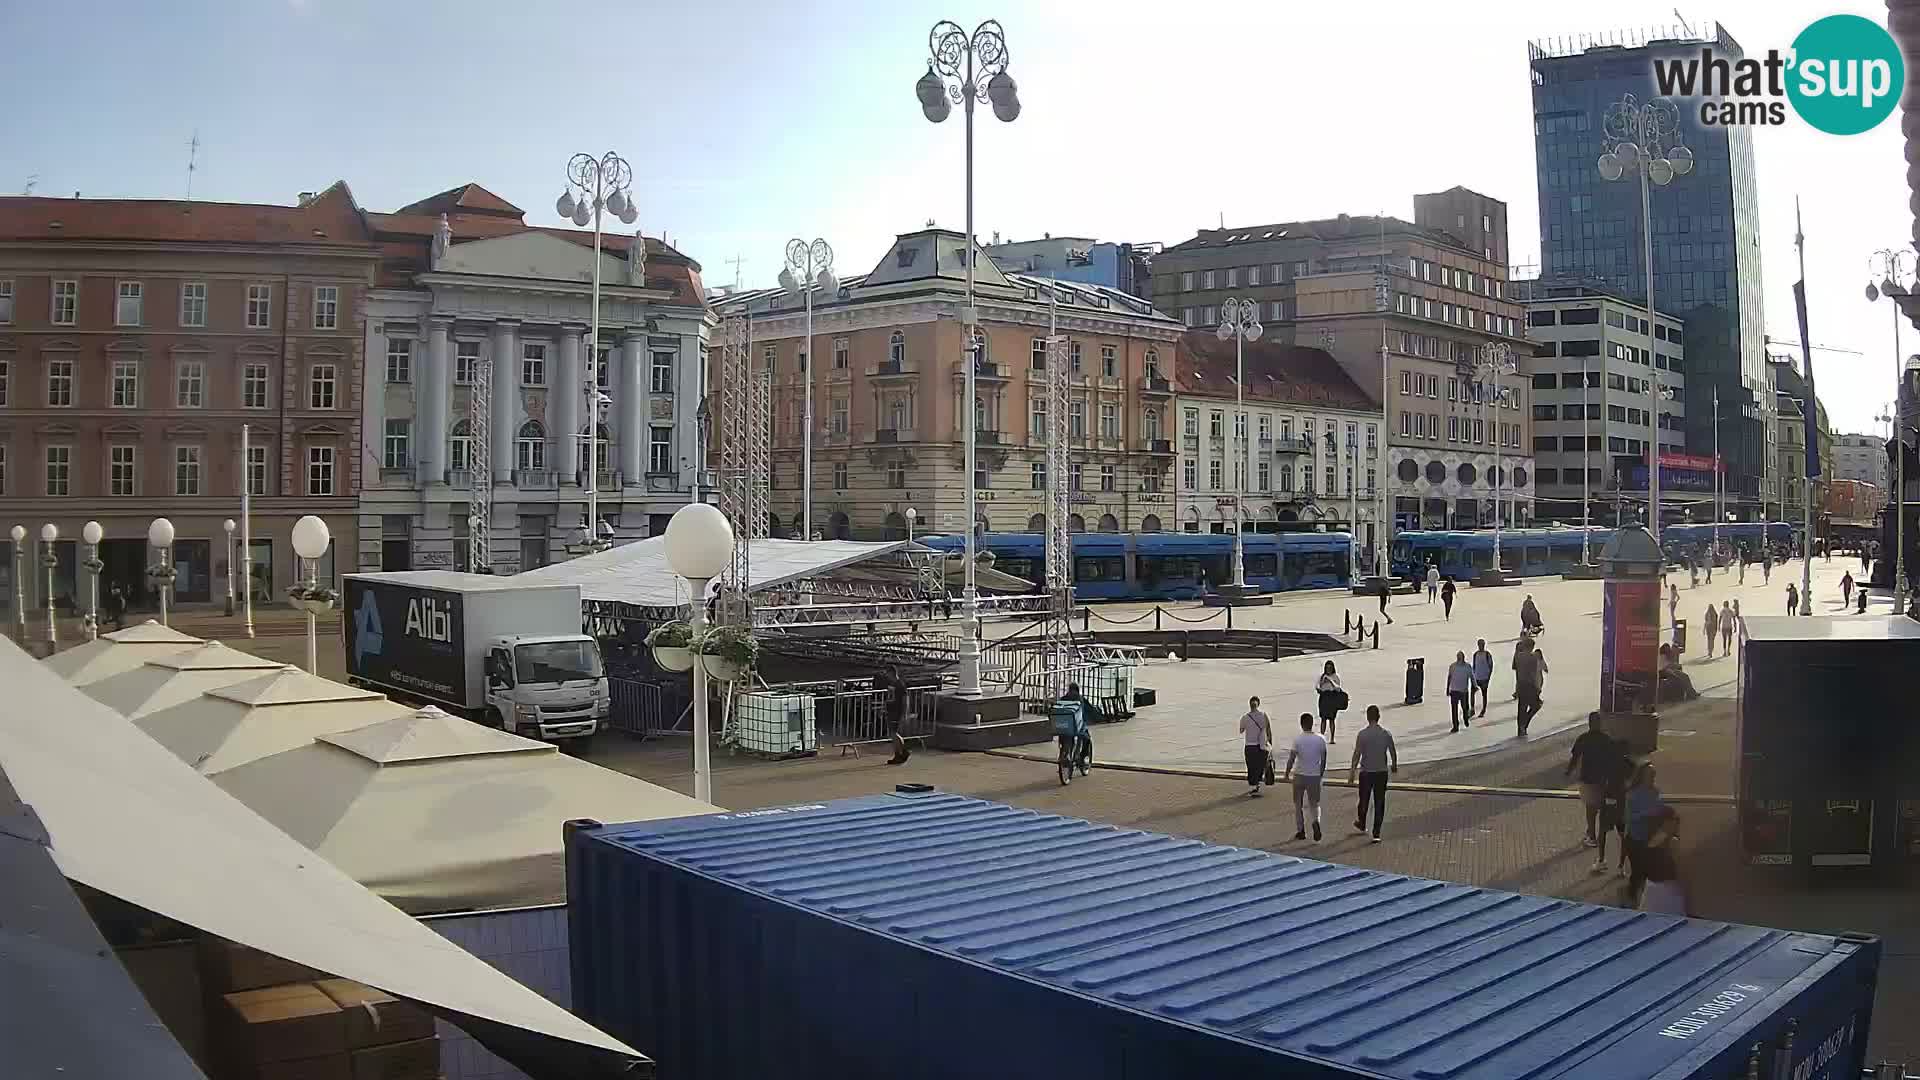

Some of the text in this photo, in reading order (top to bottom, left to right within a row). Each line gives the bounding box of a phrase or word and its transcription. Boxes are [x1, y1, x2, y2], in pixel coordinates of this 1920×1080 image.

[405, 597, 452, 643] Alibi
[1658, 1016, 1708, 1039] MCDU
[1691, 990, 1747, 1019] 300629
